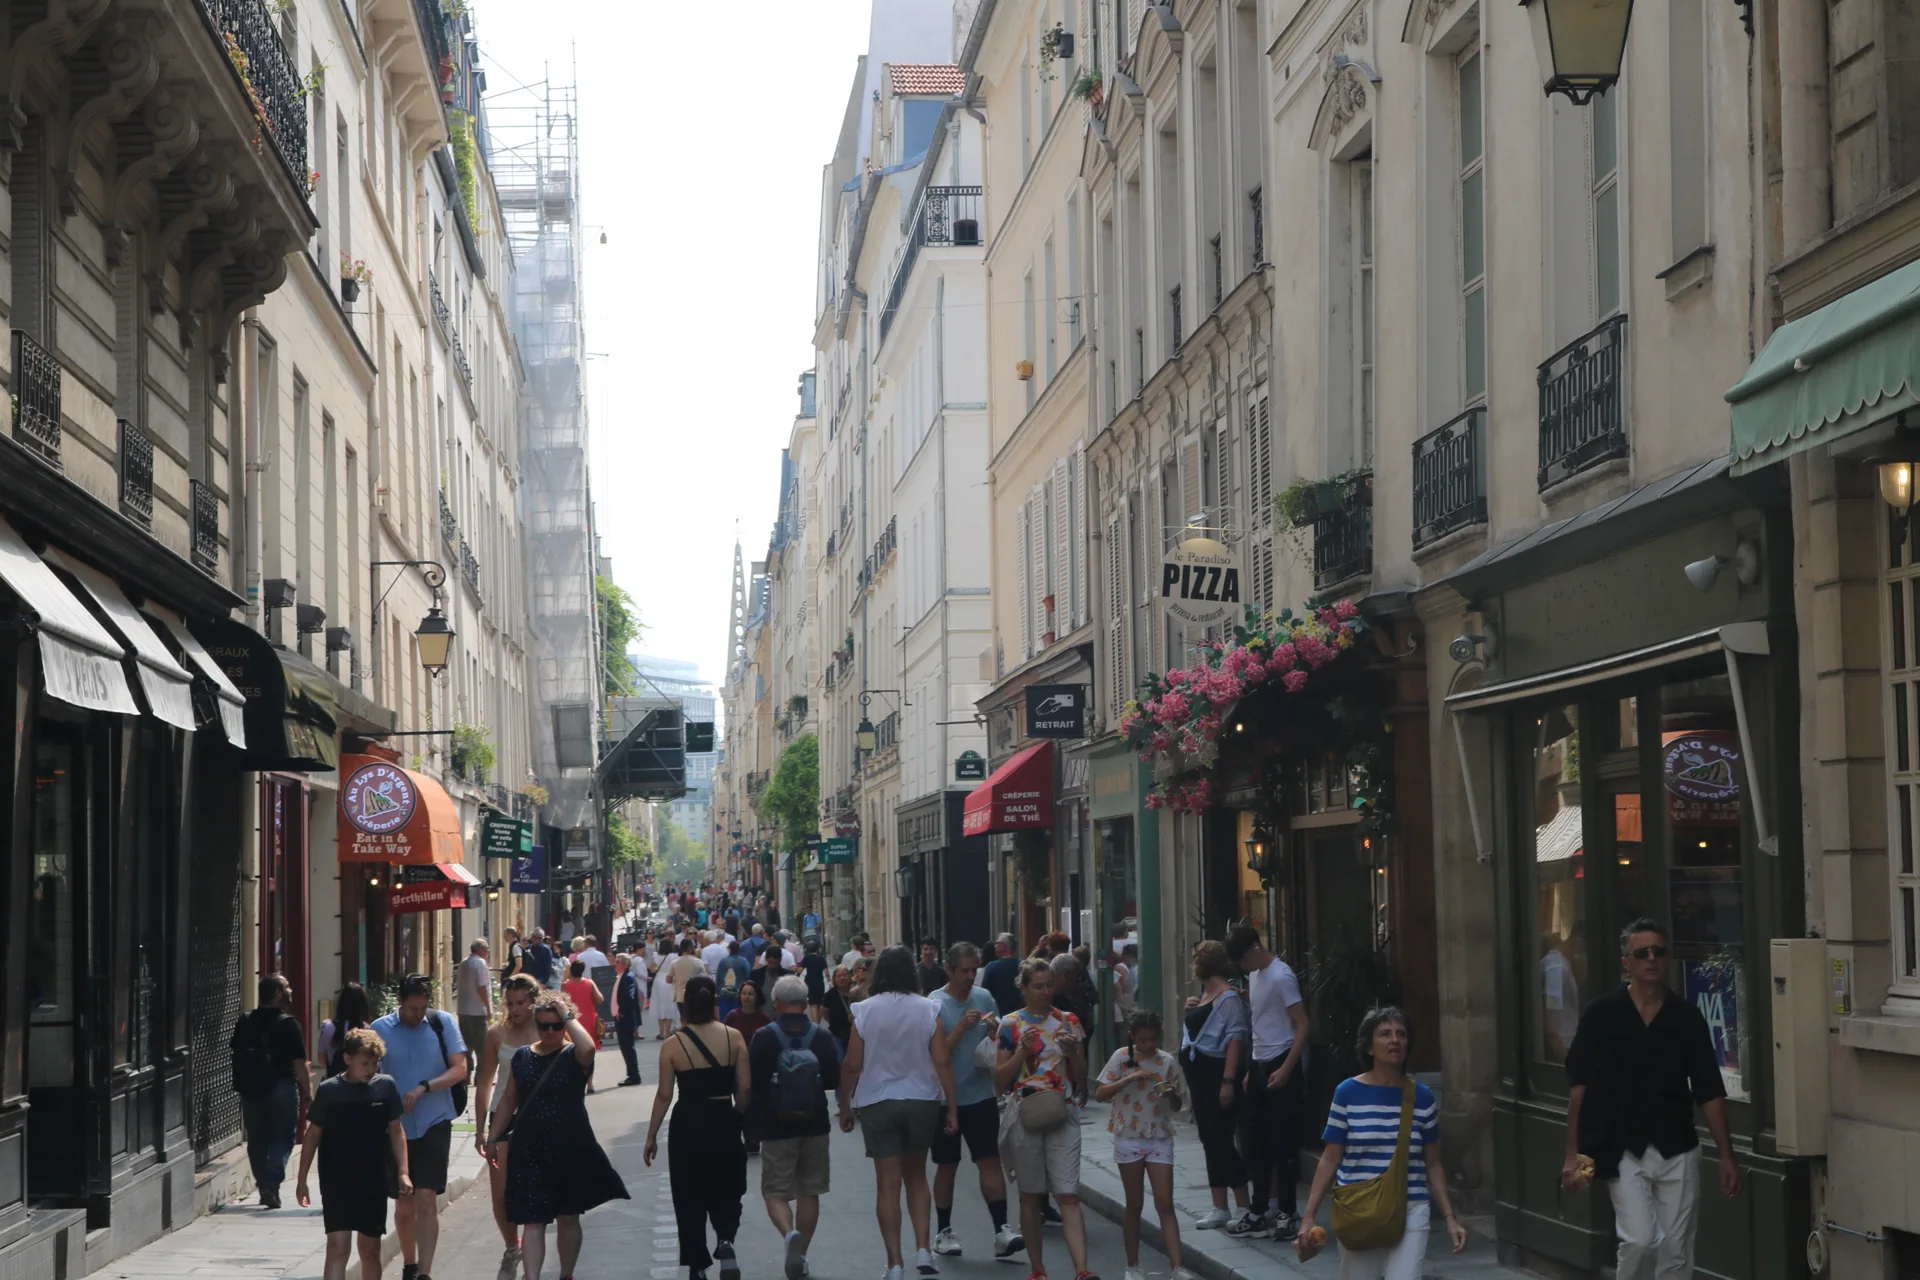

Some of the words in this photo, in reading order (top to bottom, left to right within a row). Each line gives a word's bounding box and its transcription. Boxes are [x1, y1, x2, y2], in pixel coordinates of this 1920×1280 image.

[1174, 550, 1184, 561] le
[1187, 551, 1231, 565] Paradiso
[1161, 563, 1239, 603] PIZZA
[1035, 720, 1075, 729] RETRAIT
[348, 788, 359, 803] Au
[354, 770, 375, 787] Lys
[377, 768, 411, 805] D'Argent
[1002, 791, 1041, 800] CRÊPERIE
[1005, 804, 1037, 813] SALON
[356, 815, 401, 831] Crêperie
[1004, 814, 1017, 822] DE
[1021, 812, 1041, 822] THÉ
[356, 832, 377, 843] Eat
[381, 832, 394, 843] in
[398, 833, 408, 843] &
[352, 844, 383, 855] Take
[386, 844, 412, 857] Way
[392, 890, 444, 908] Berthillon
